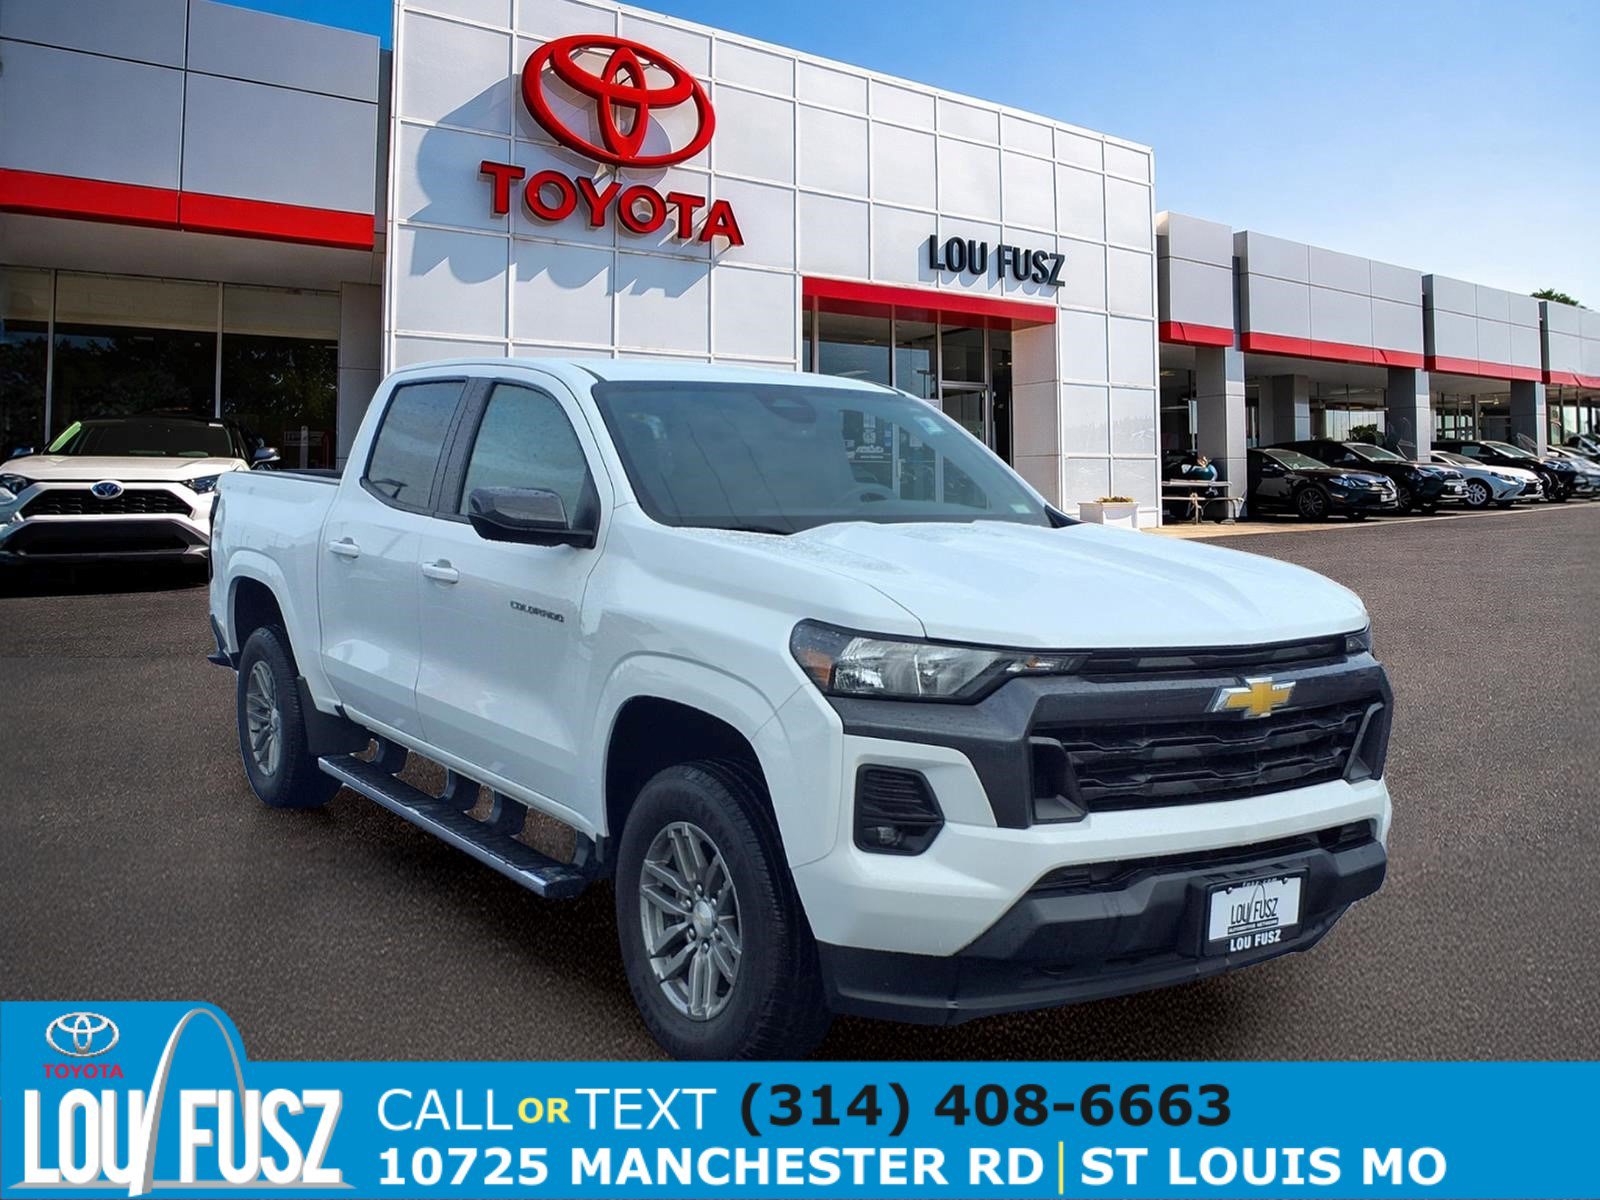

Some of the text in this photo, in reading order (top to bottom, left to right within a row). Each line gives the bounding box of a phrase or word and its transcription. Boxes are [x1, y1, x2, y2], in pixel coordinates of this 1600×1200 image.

[479, 160, 744, 246] TOYOTA
[929, 234, 1066, 288] LOU FUSZ
[1231, 897, 1279, 925] LOU FUSZ
[1229, 929, 1282, 952] LOU FUSZ
